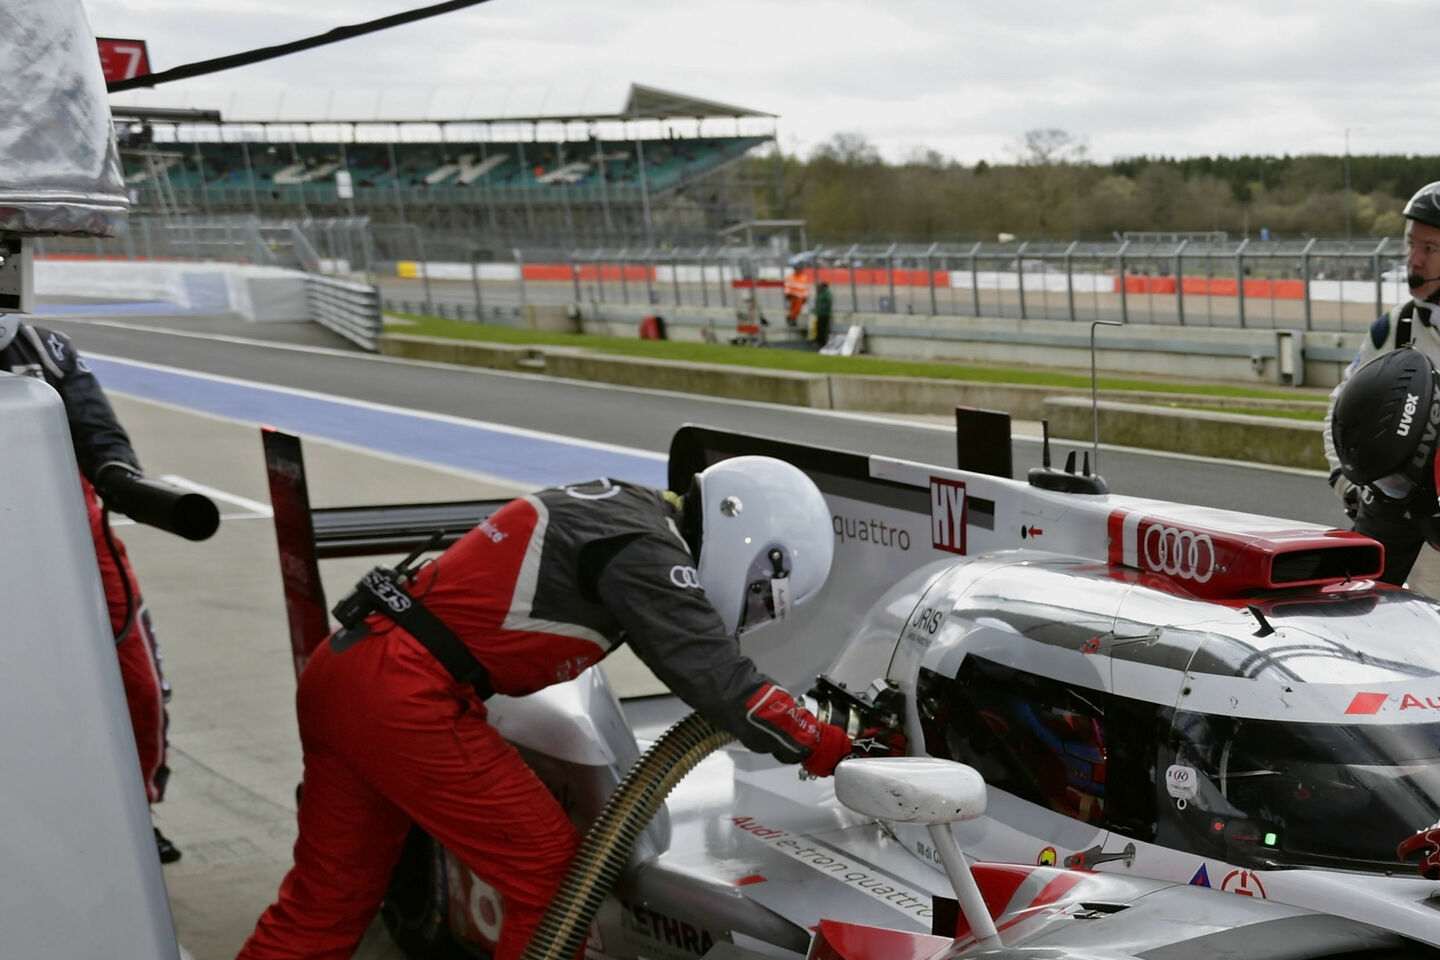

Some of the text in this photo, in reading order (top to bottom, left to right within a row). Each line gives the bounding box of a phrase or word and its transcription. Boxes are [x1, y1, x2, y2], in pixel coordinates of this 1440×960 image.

[1397, 393, 1419, 436] uvex
[833, 515, 910, 551] quattro
[931, 482, 966, 550] HY
[732, 816, 933, 918] Audi e-tron quattro
